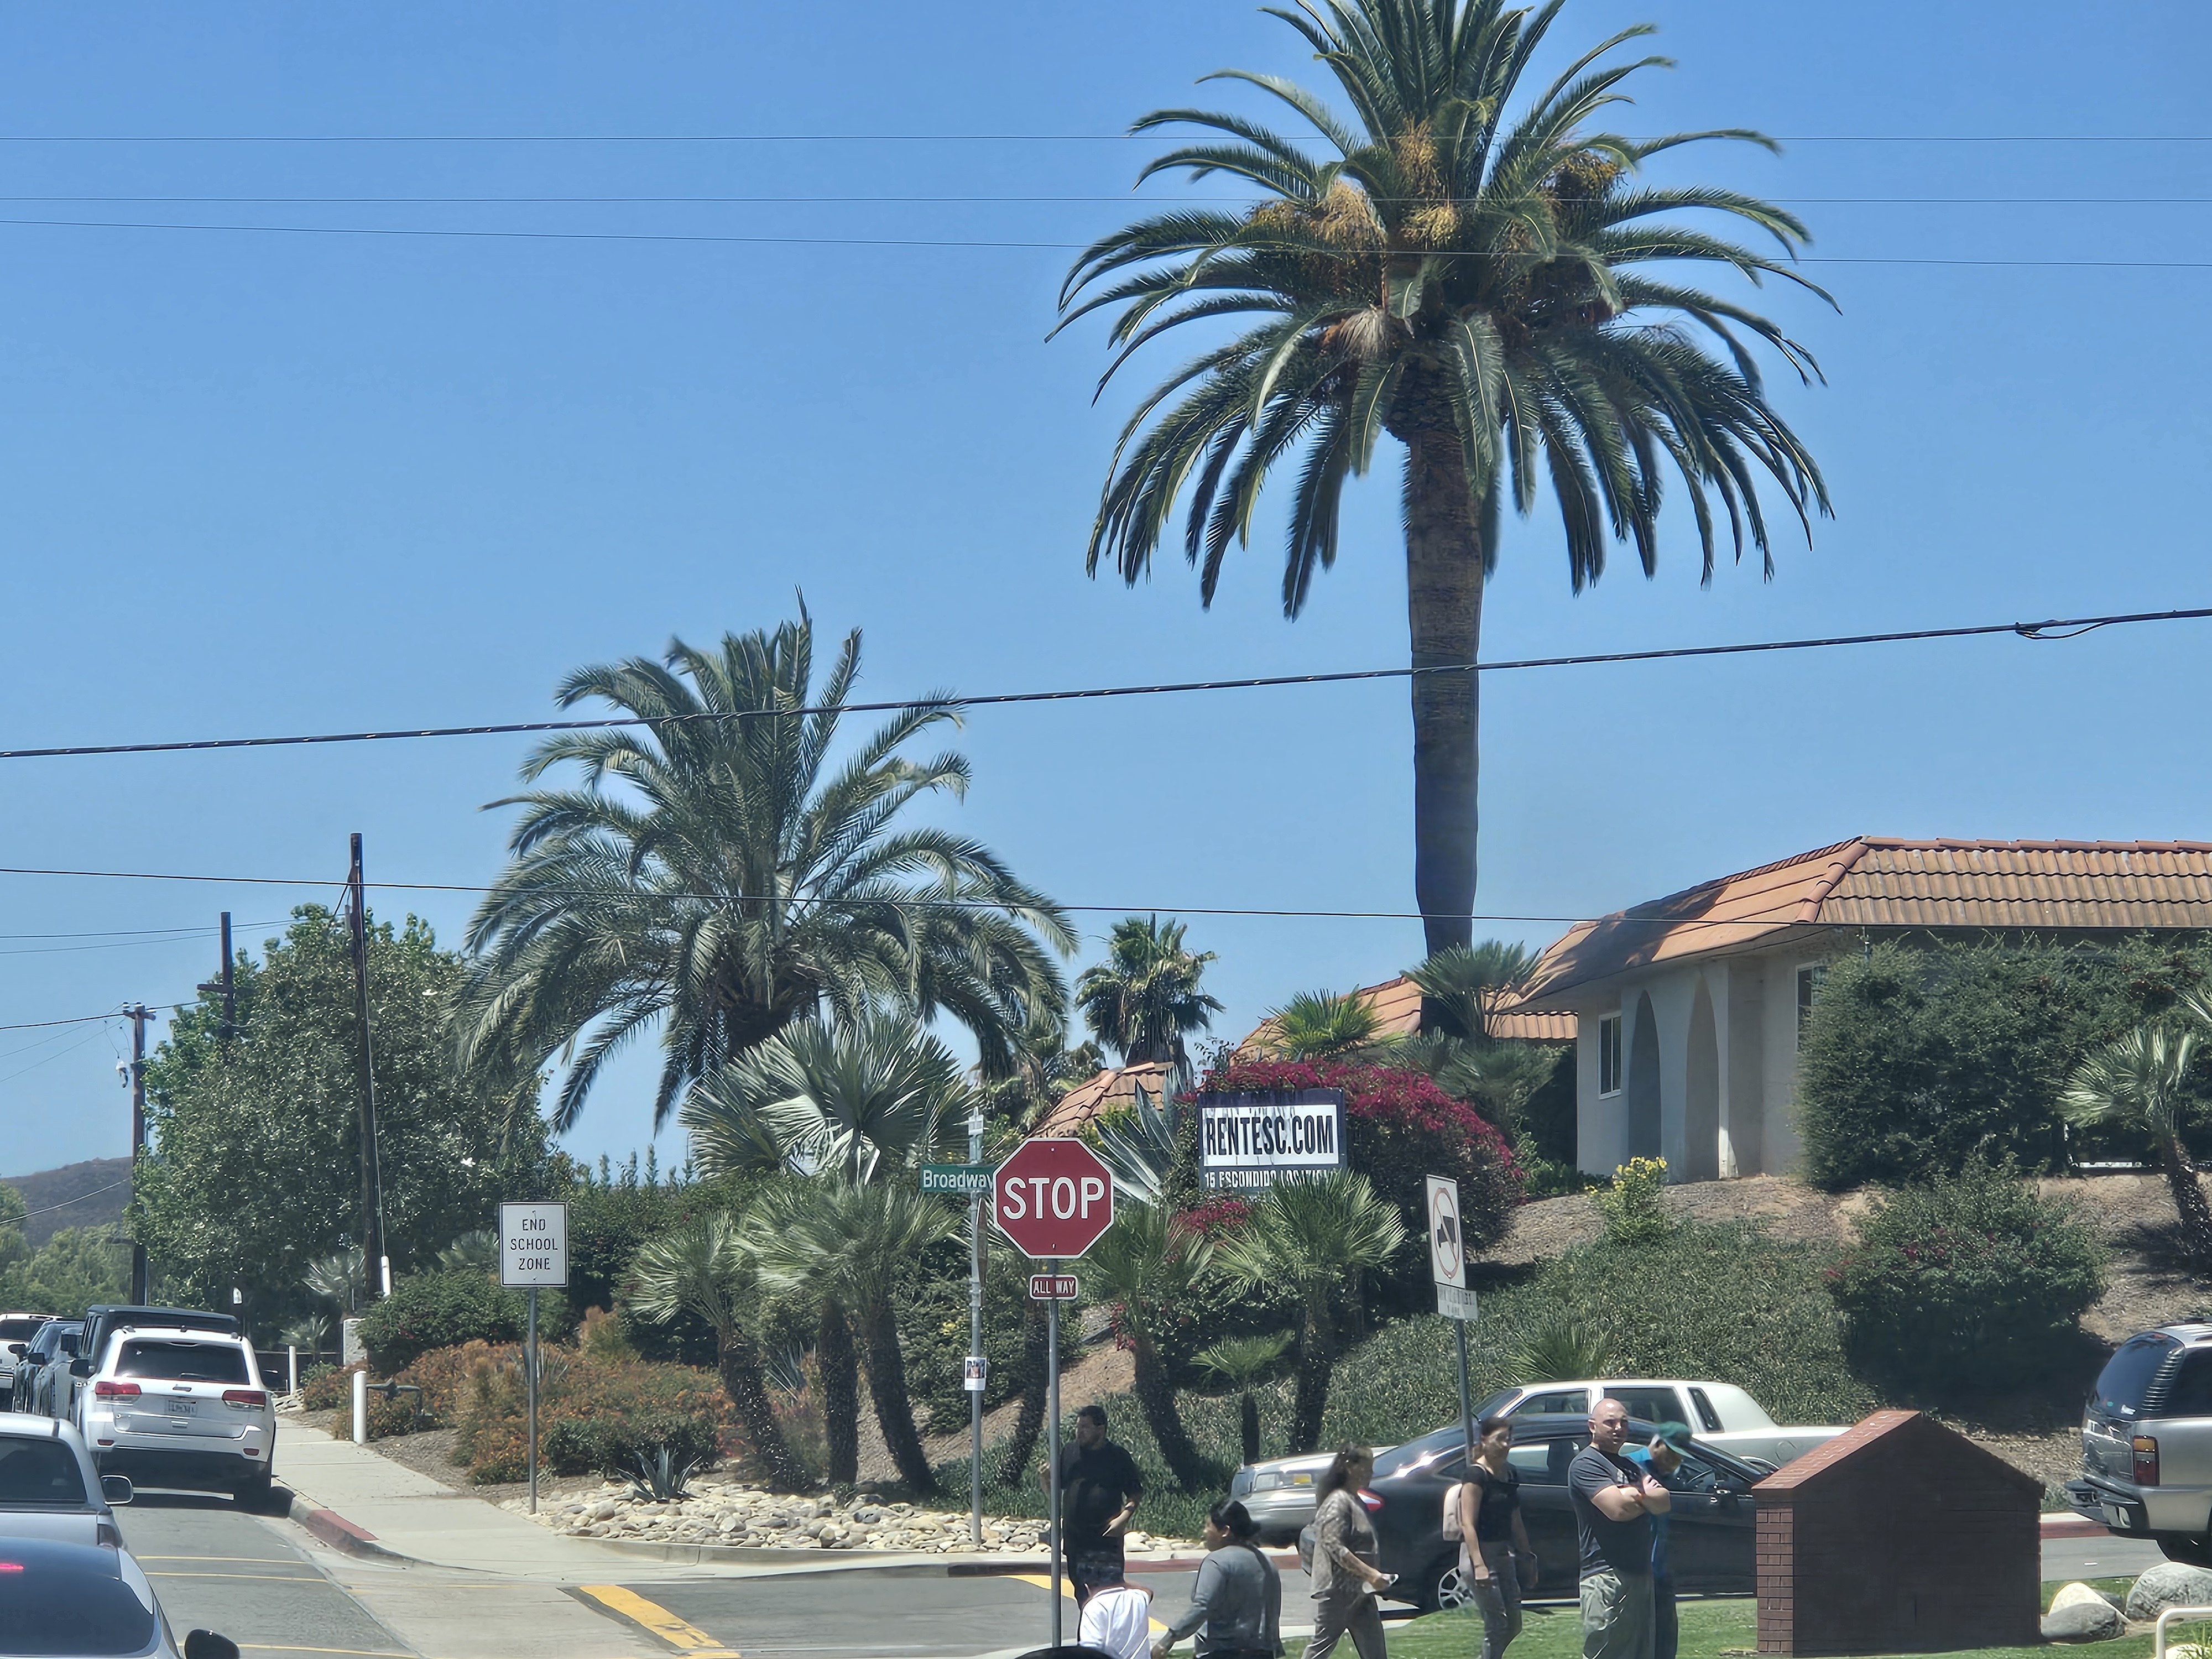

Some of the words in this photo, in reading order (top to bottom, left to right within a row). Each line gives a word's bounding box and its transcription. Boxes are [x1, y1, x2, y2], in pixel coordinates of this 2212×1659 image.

[1207, 1115, 1334, 1155] RENTESC.COM
[1003, 1177, 1104, 1219] STOP
[523, 1219, 546, 1230] END
[510, 1238, 558, 1250] SCHOOL
[518, 1258, 550, 1270] ZONE
[1033, 1280, 1051, 1293] ALL
[1056, 1280, 1074, 1293] WAY
